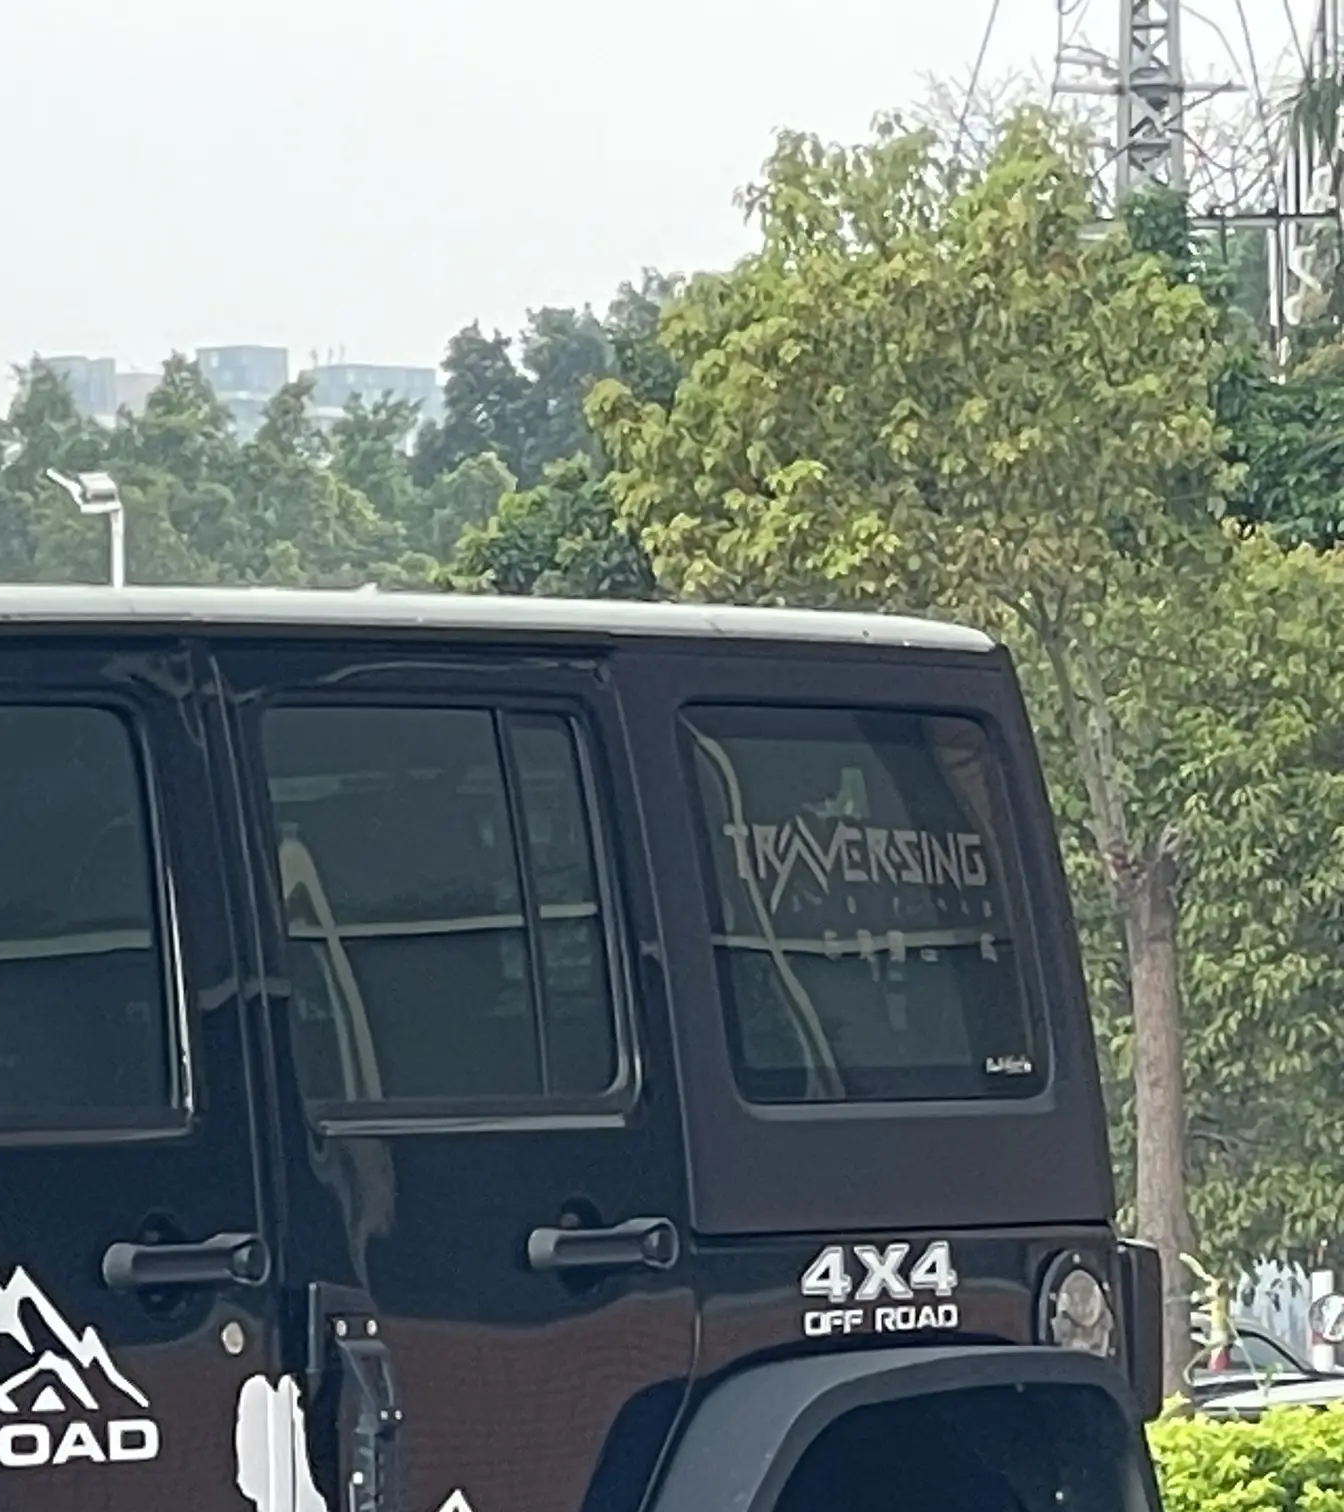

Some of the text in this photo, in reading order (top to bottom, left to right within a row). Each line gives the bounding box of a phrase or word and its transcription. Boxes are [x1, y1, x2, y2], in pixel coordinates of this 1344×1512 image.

[723, 815, 988, 915] TRAVERSING
[801, 1240, 958, 1304] 4X4
[804, 1304, 958, 1336] OFF ROAD
